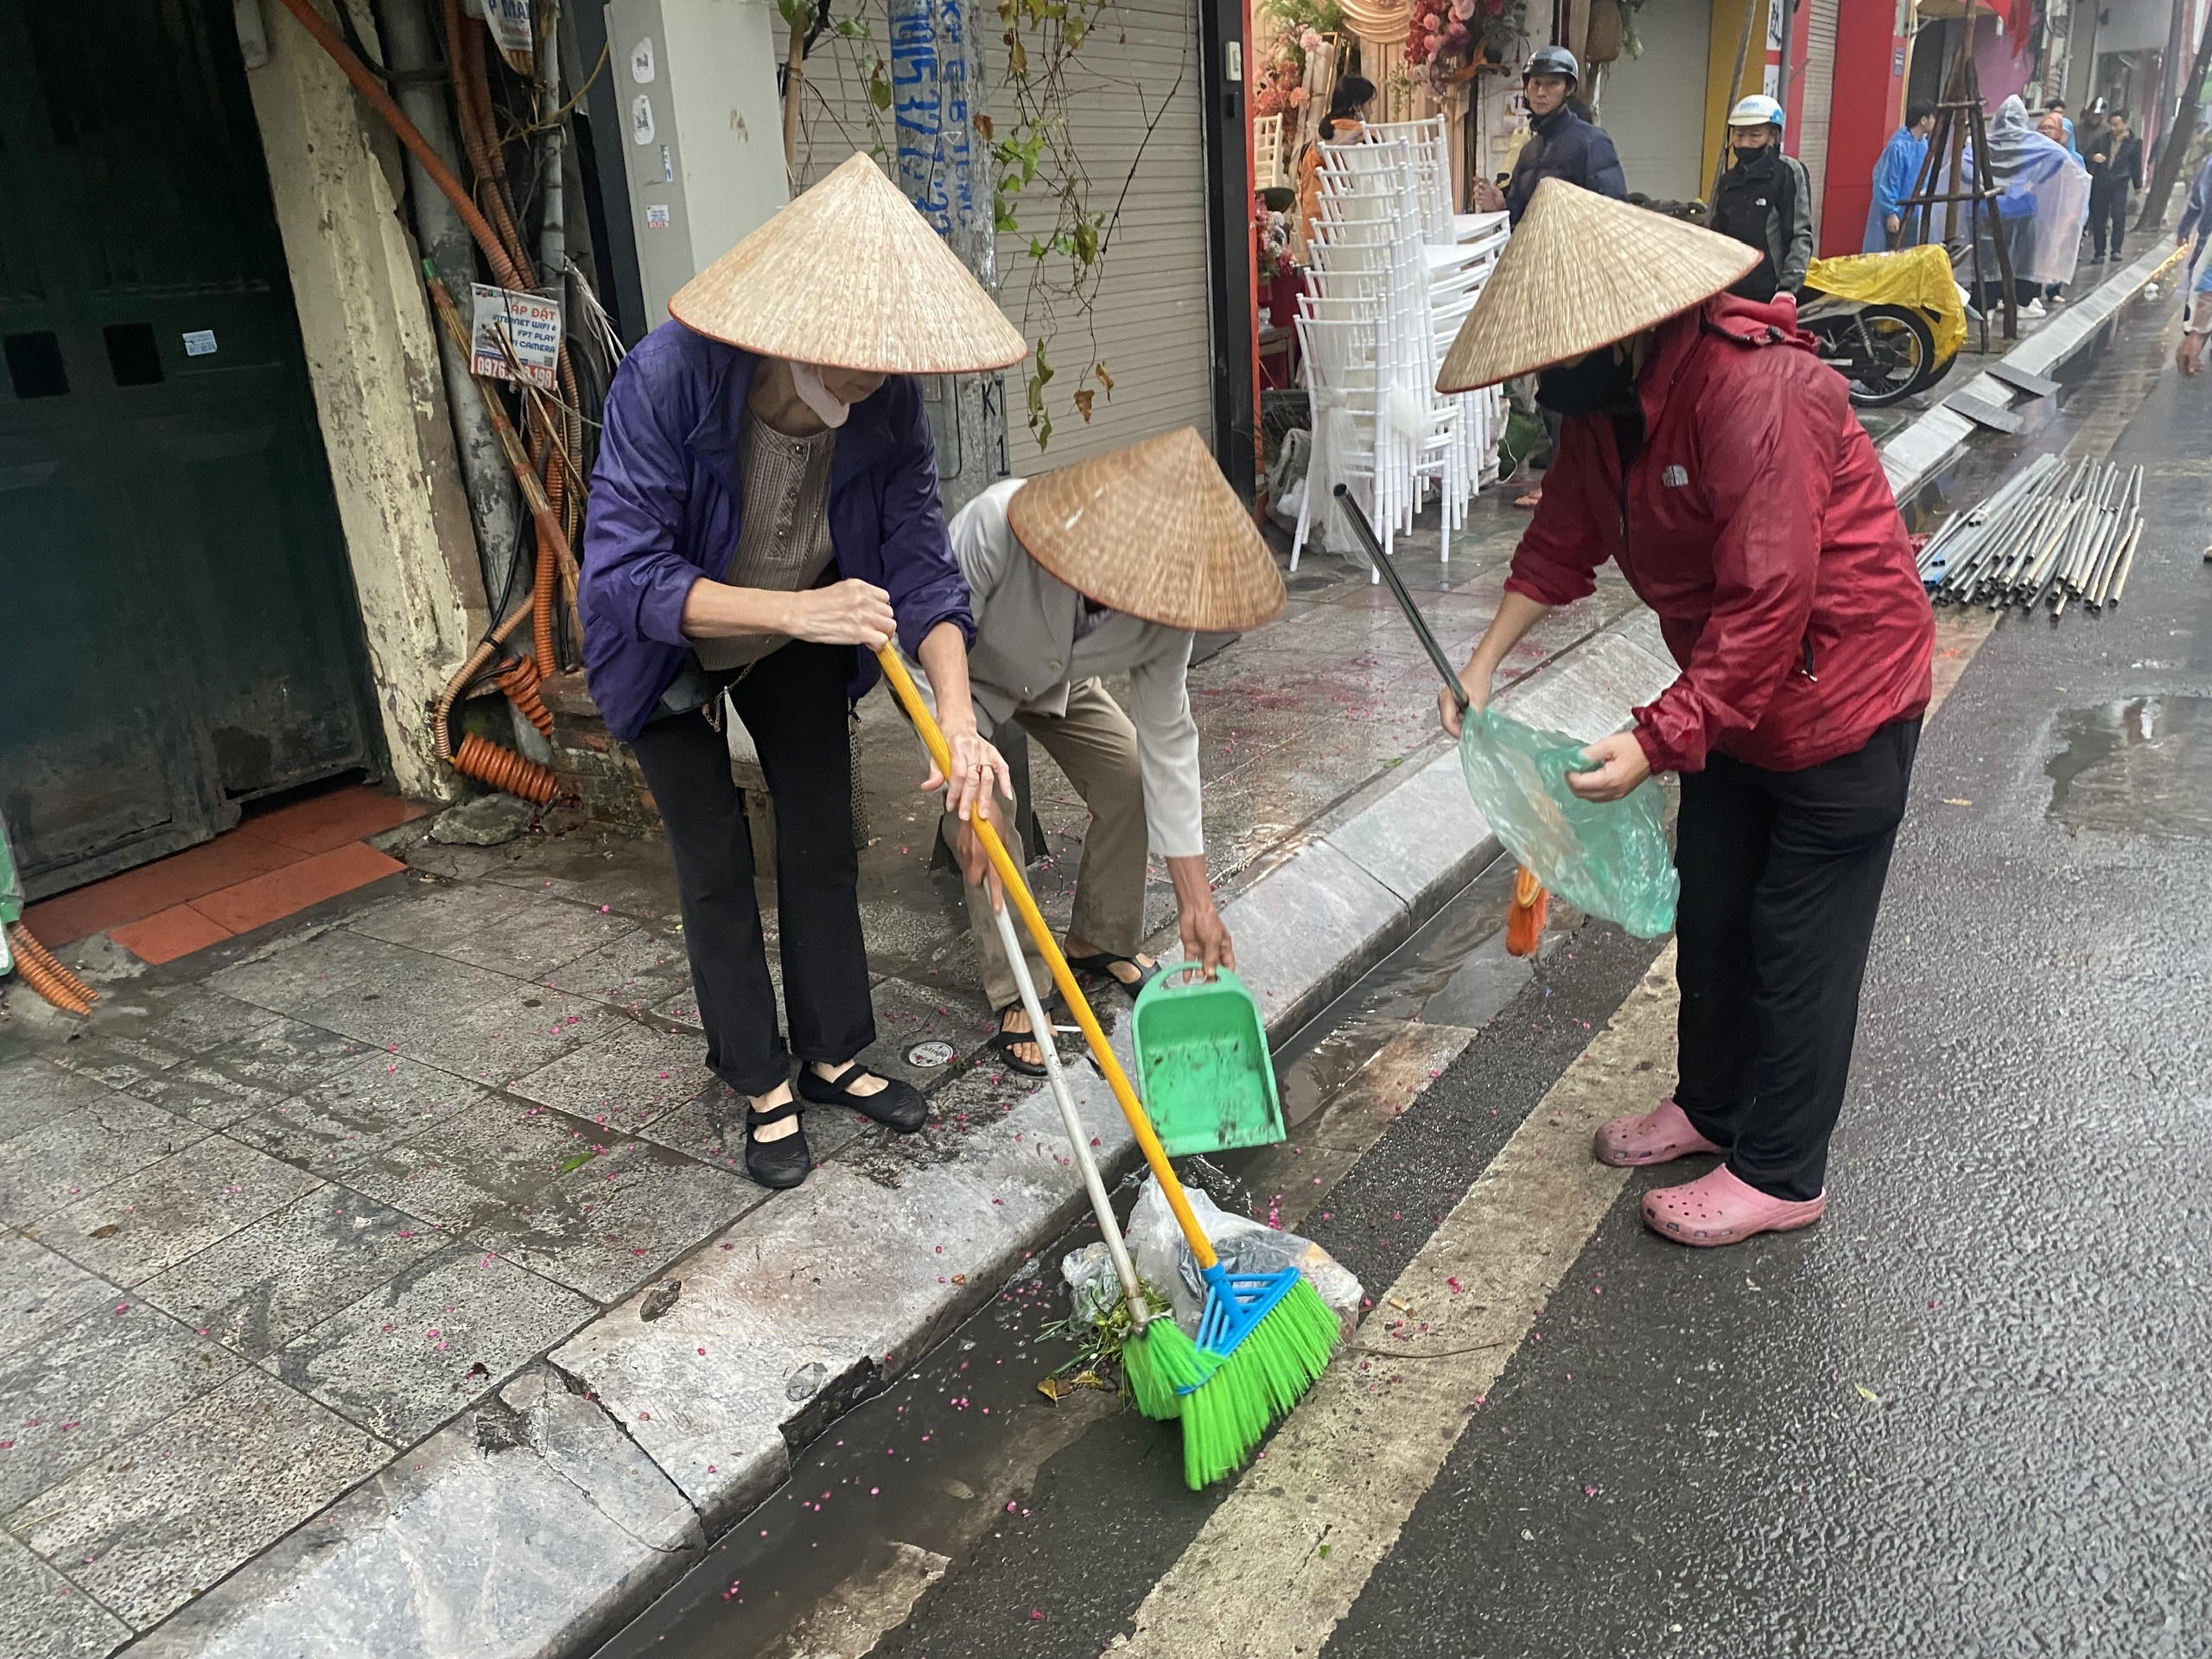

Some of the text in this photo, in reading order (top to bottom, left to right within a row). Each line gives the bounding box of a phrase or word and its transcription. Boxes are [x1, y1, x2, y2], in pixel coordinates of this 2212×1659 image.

[531, 307, 556, 321] ĐẶT
[531, 321, 550, 331] WIFI
[534, 332, 556, 342] PLAY
[519, 340, 556, 353] CAMERA
